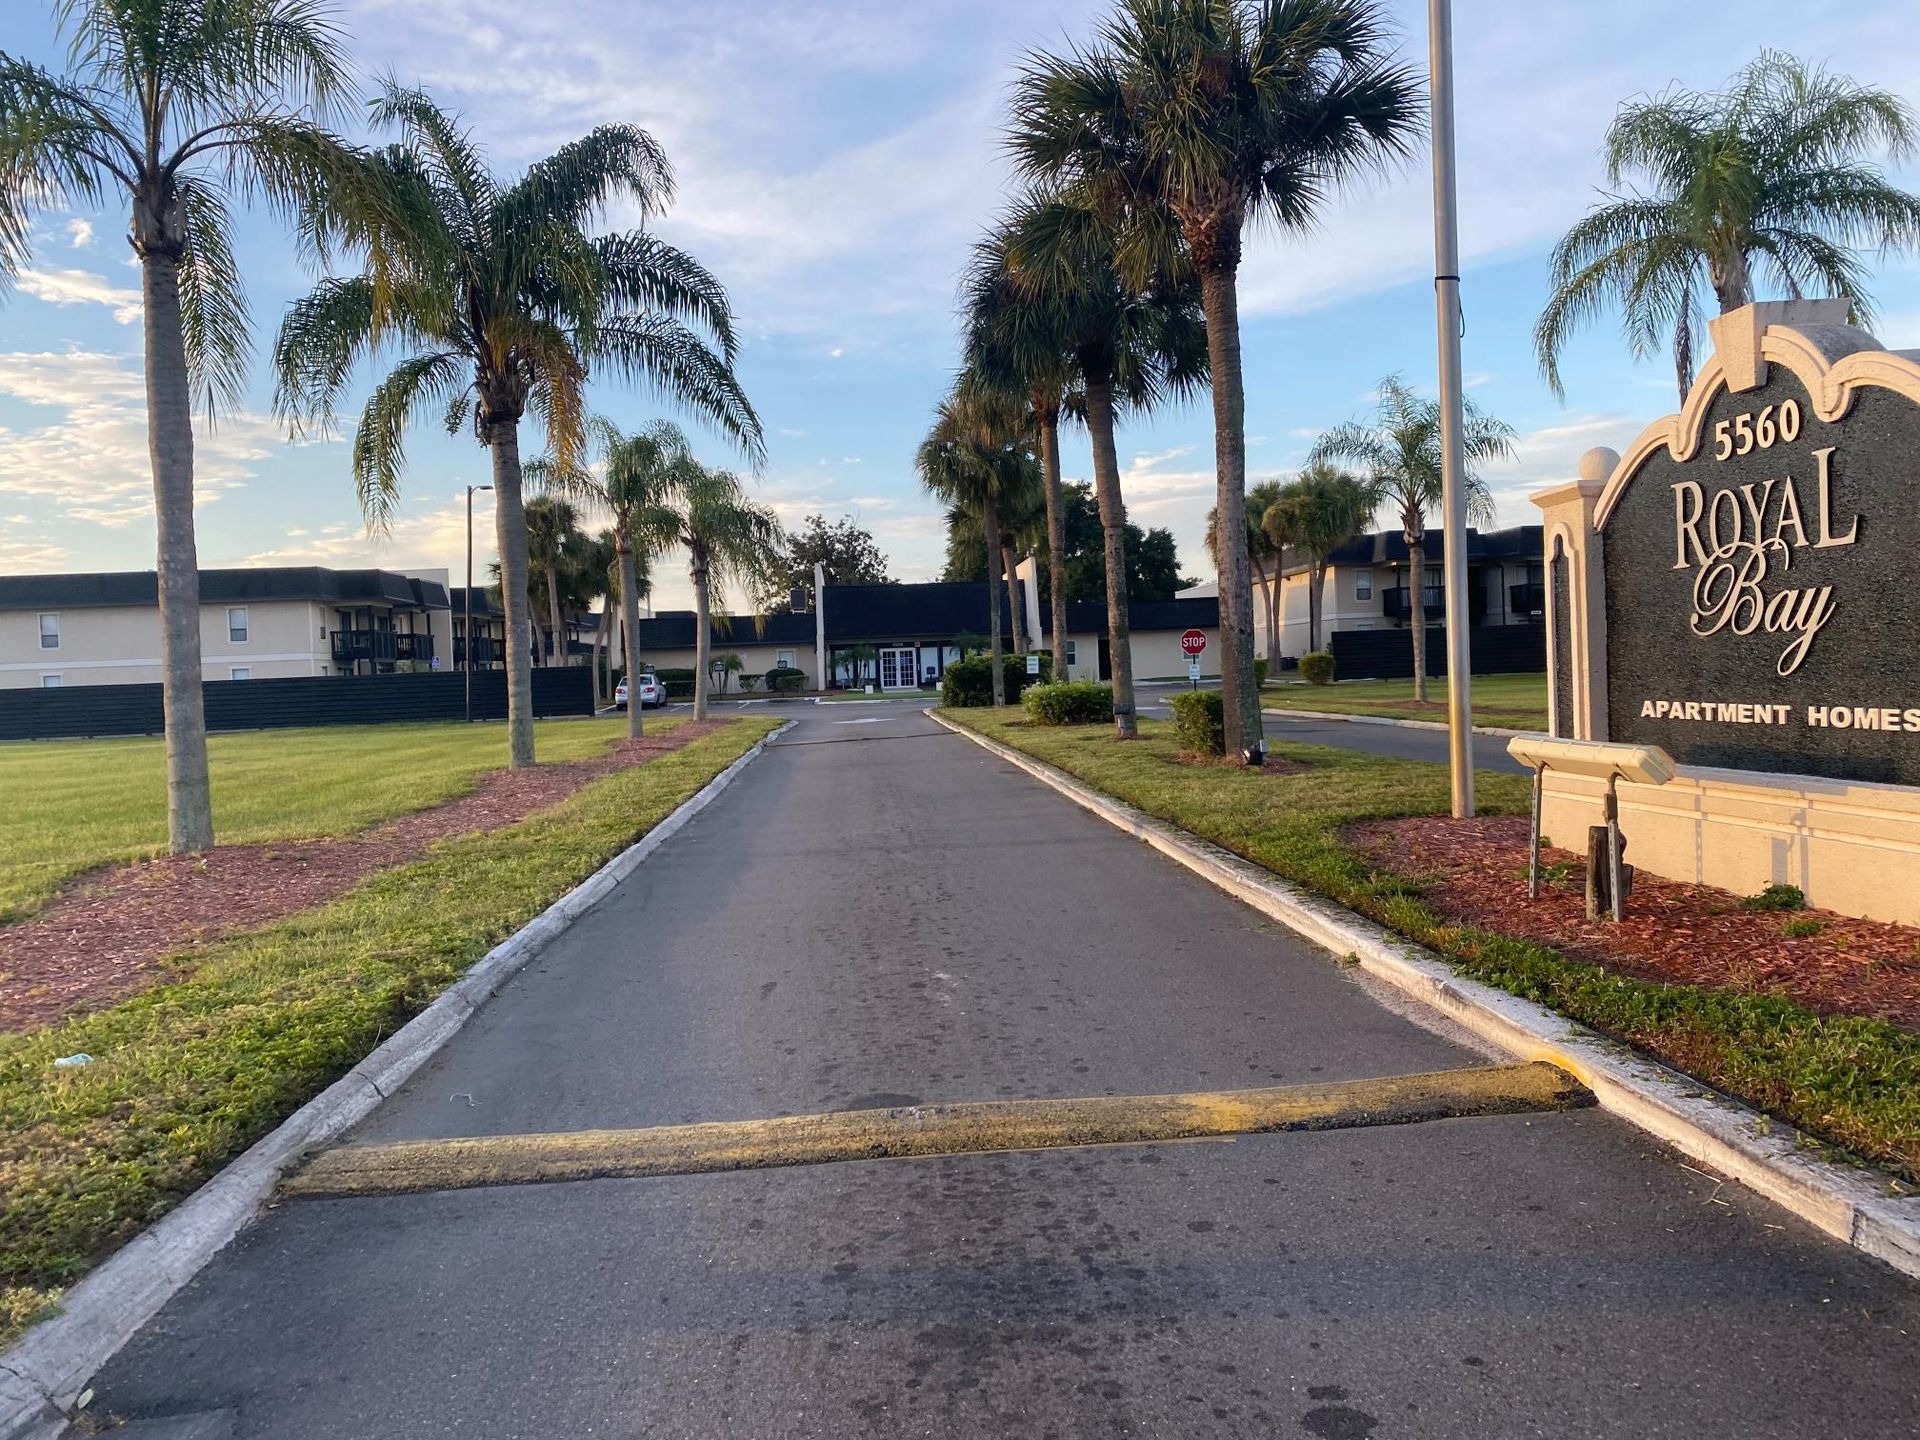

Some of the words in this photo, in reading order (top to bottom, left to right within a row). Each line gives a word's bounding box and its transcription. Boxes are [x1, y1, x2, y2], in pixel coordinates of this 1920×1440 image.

[1715, 399, 1800, 461] 5560
[1670, 446, 1858, 569] ROYAL
[1690, 537, 1836, 676] Bay
[1183, 637, 1205, 647] STOP
[1641, 700, 1791, 725] APARTMENT
[1808, 706, 1920, 732] HOMES
